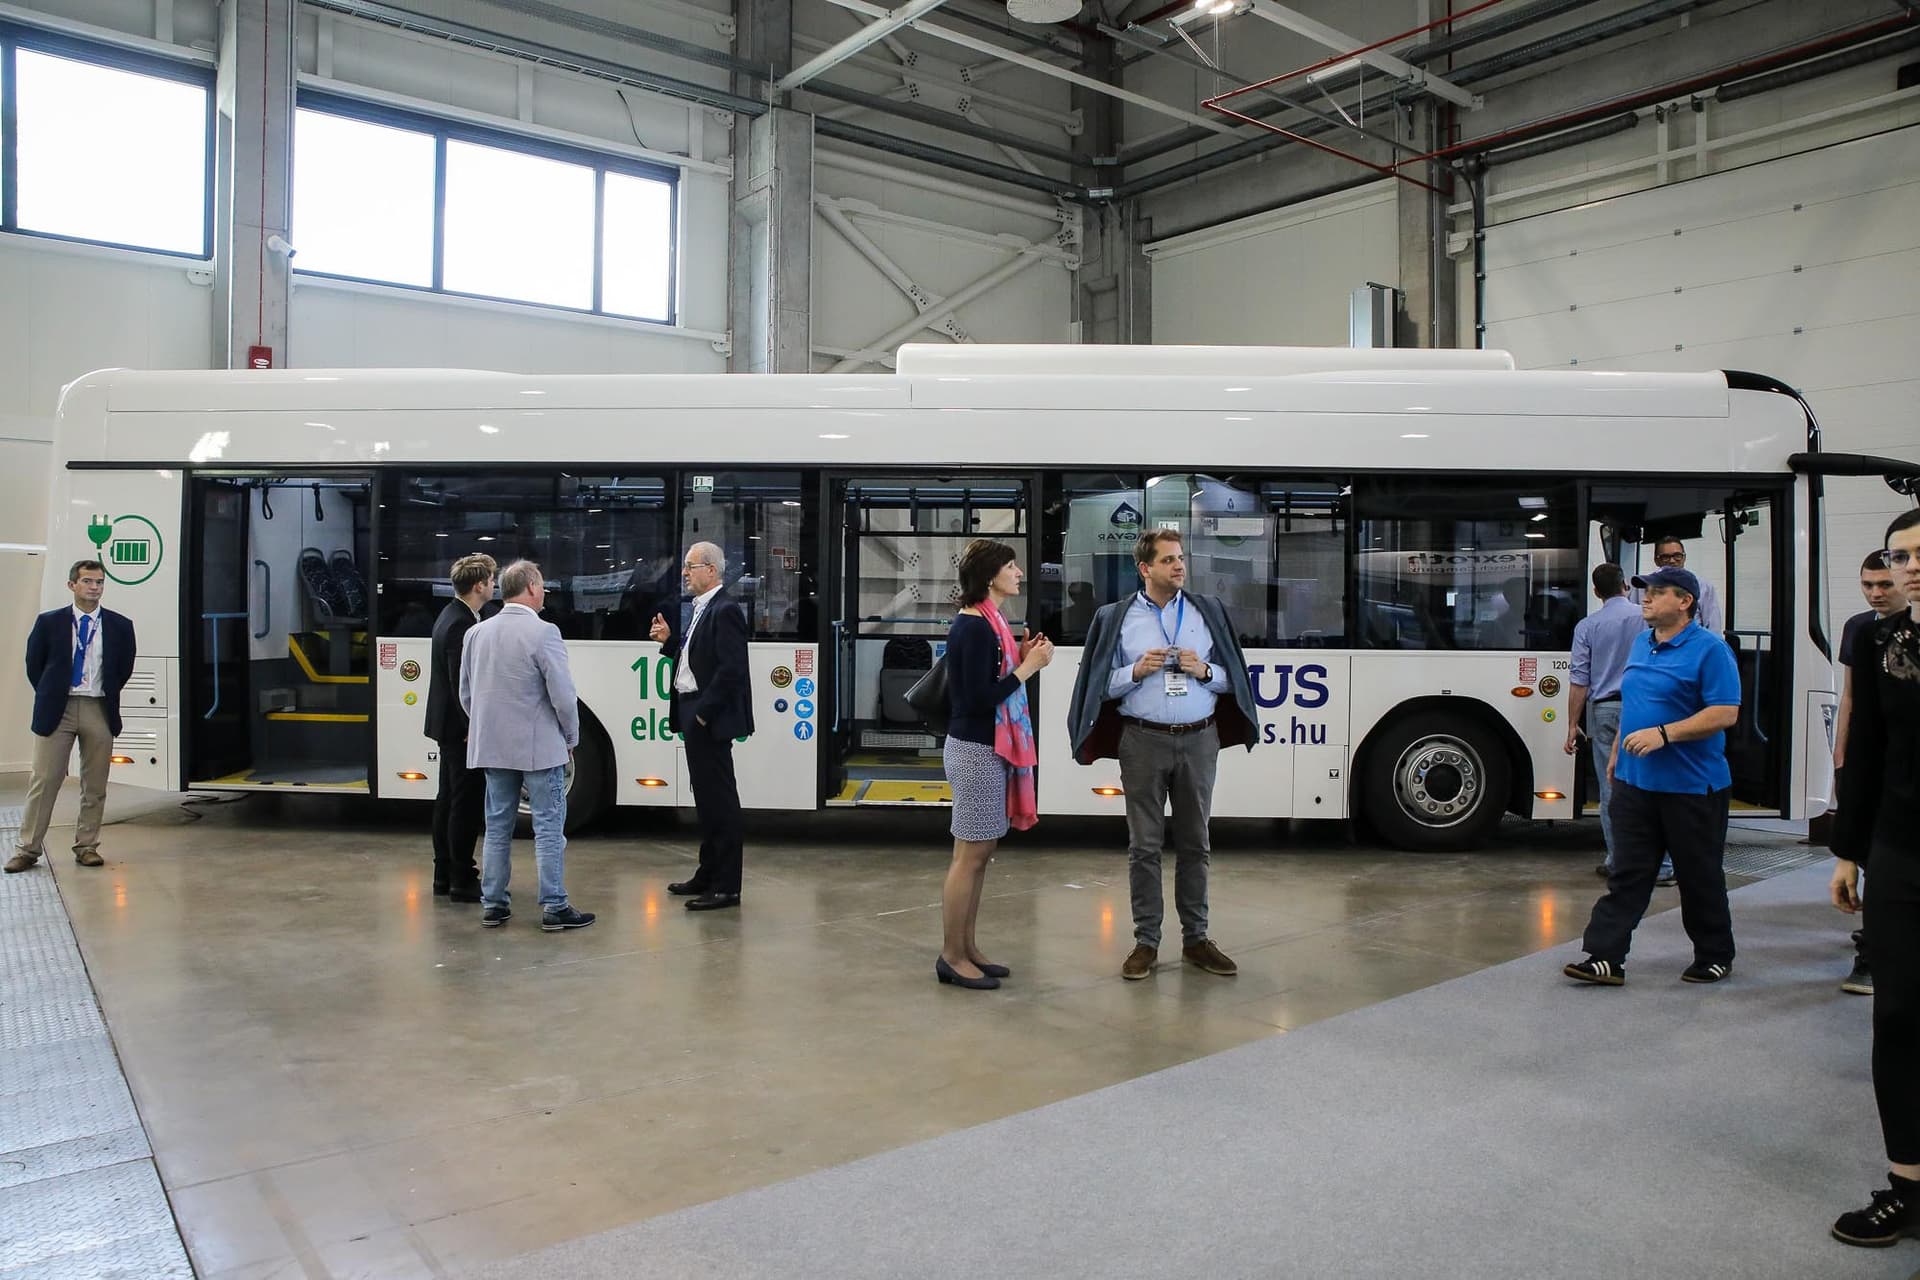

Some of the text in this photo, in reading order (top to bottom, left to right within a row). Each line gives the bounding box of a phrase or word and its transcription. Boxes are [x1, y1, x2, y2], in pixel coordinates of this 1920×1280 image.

[631, 656, 673, 700] 10
[1247, 664, 1329, 709] US
[1262, 716, 1326, 744] s.hu
